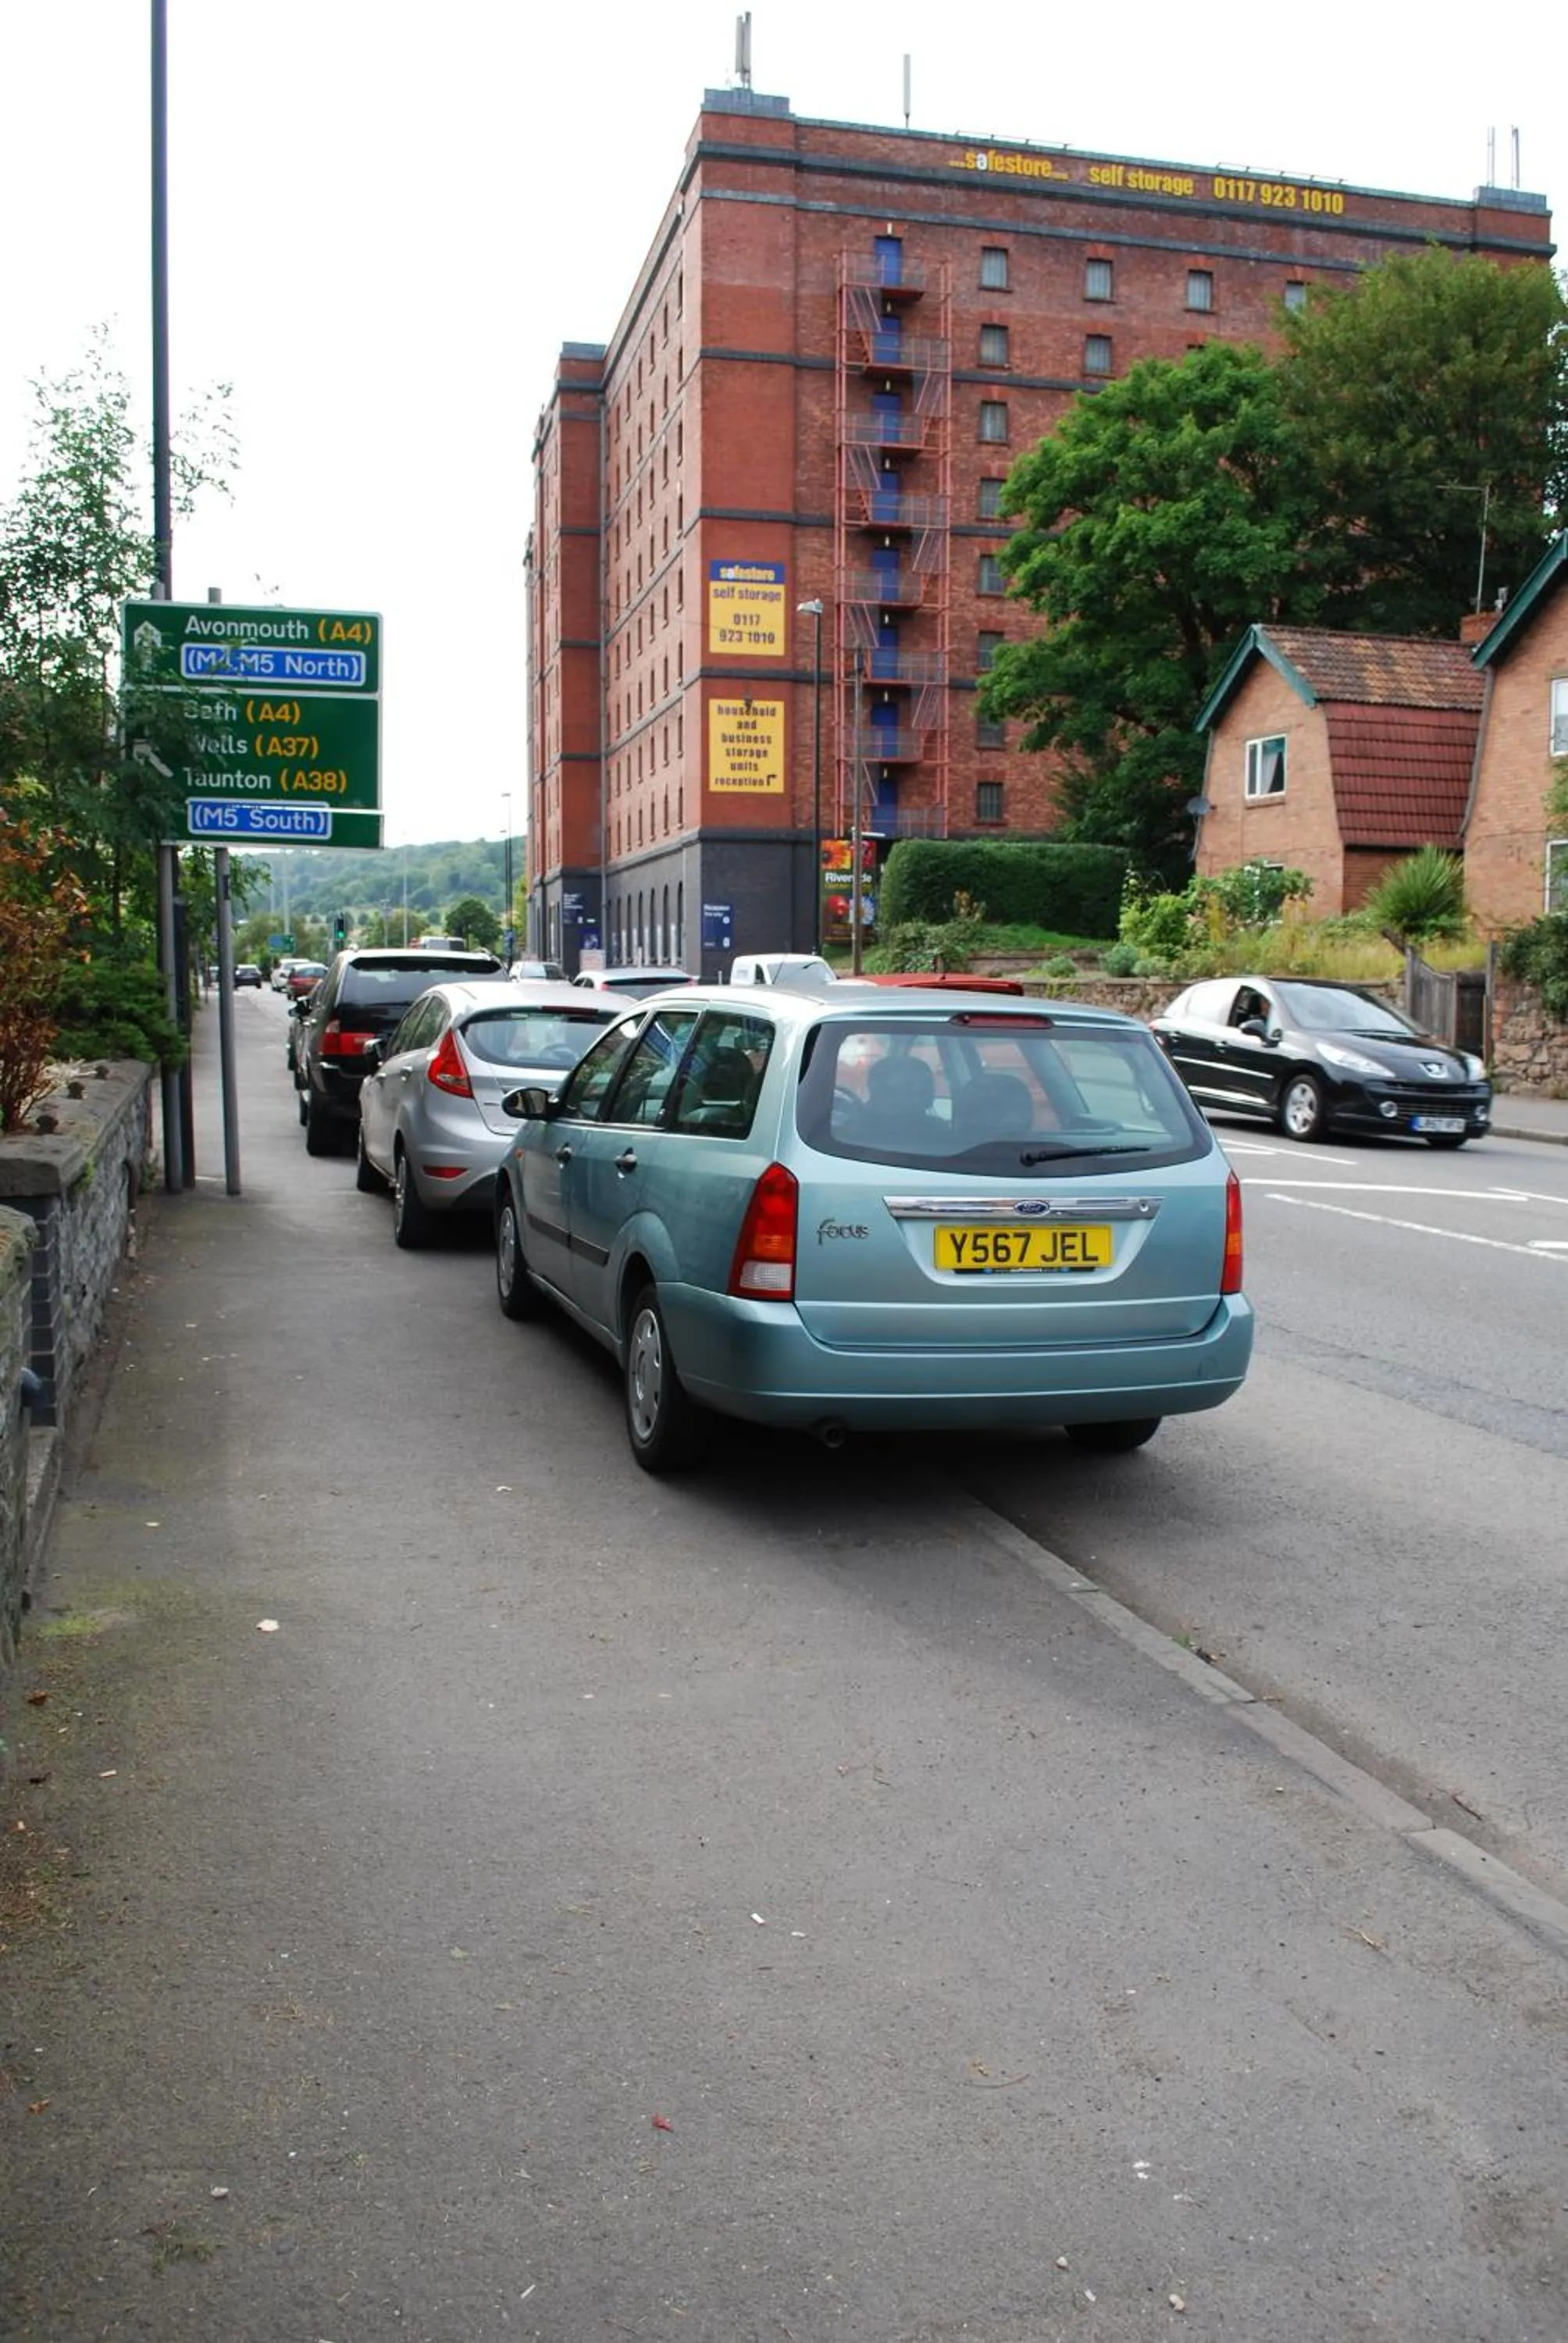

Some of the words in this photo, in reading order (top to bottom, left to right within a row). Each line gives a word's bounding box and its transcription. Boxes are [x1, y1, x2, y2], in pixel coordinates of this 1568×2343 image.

[1089, 163, 1124, 187] self
[1126, 168, 1194, 196] storage
[1213, 176, 1256, 201] 0117
[1260, 182, 1297, 209] 923
[1300, 188, 1344, 215] 1010
[713, 586, 735, 599] self
[738, 587, 782, 602] storage
[184, 615, 309, 640] Avonmouth
[317, 618, 372, 645] (A4)
[732, 612, 761, 626] 0117
[719, 629, 743, 643] 923
[748, 630, 775, 644] 1010
[284, 654, 359, 680] North)
[246, 699, 301, 726] (A4)
[736, 719, 757, 730] and
[255, 733, 319, 761] (A37)
[721, 733, 772, 744] business
[725, 747, 769, 760] storage
[730, 761, 759, 772] units
[182, 766, 273, 790] Taunton
[280, 768, 347, 794] (A38)
[194, 804, 238, 828] (M5
[248, 808, 326, 834] South)
[949, 1231, 1032, 1264] Y567
[1040, 1231, 1099, 1263] JEL
